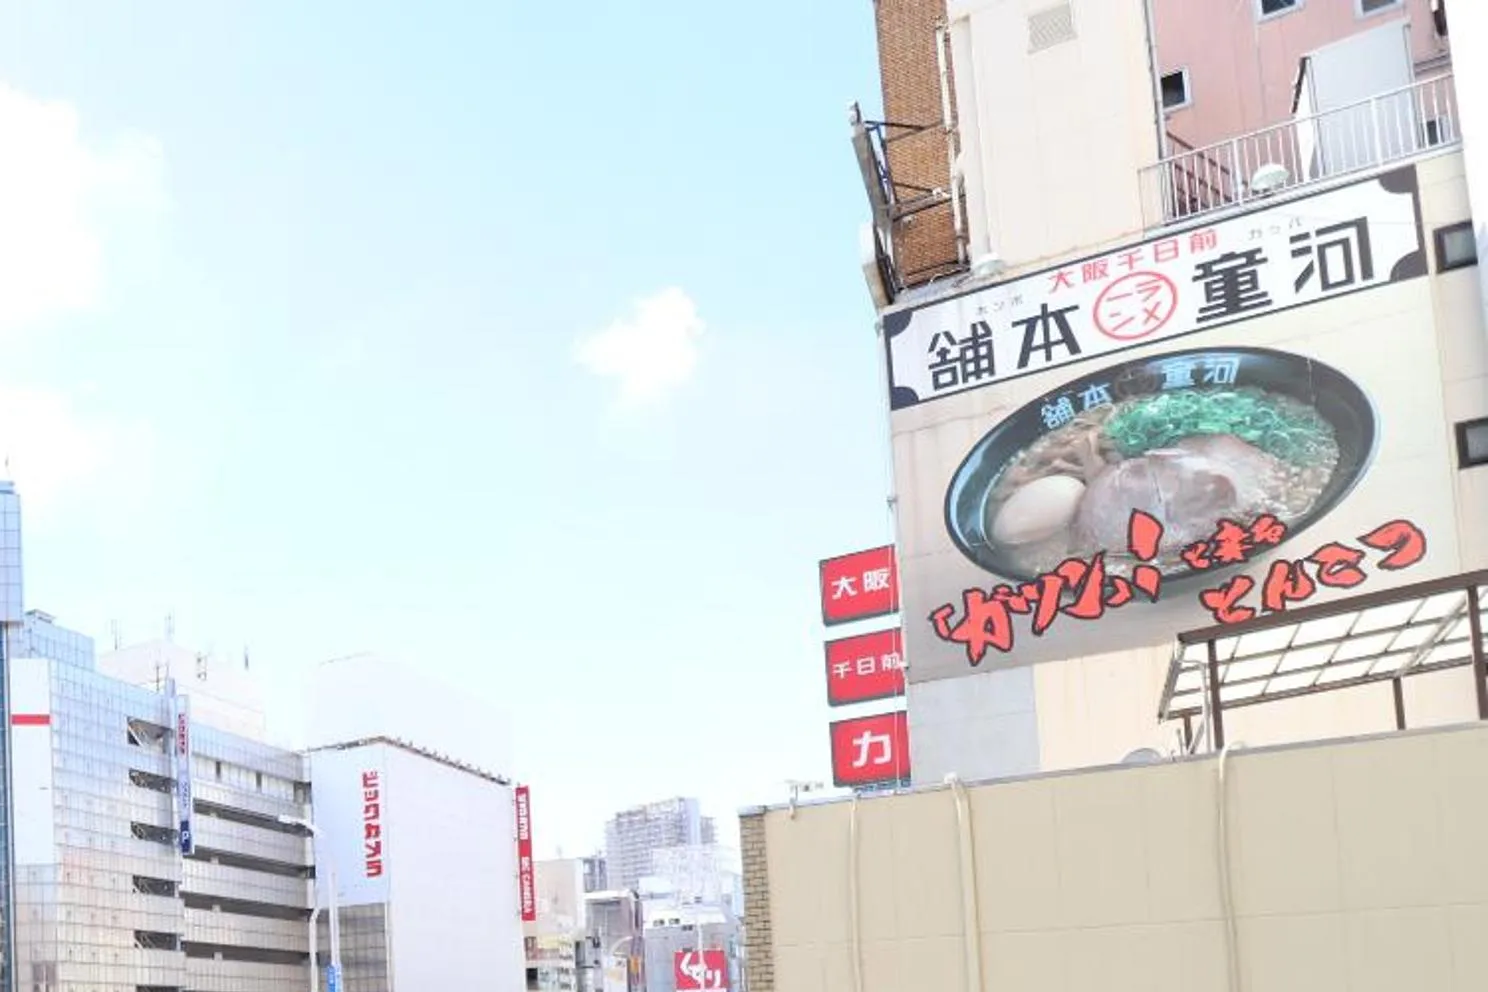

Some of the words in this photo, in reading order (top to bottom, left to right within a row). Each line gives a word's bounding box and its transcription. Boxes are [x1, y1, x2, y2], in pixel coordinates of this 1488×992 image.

[1049, 229, 1218, 294] 大阪千日前
[832, 568, 891, 599] 大阪
[833, 653, 902, 679] 千日前
[363, 771, 382, 877] ビックカメラ
